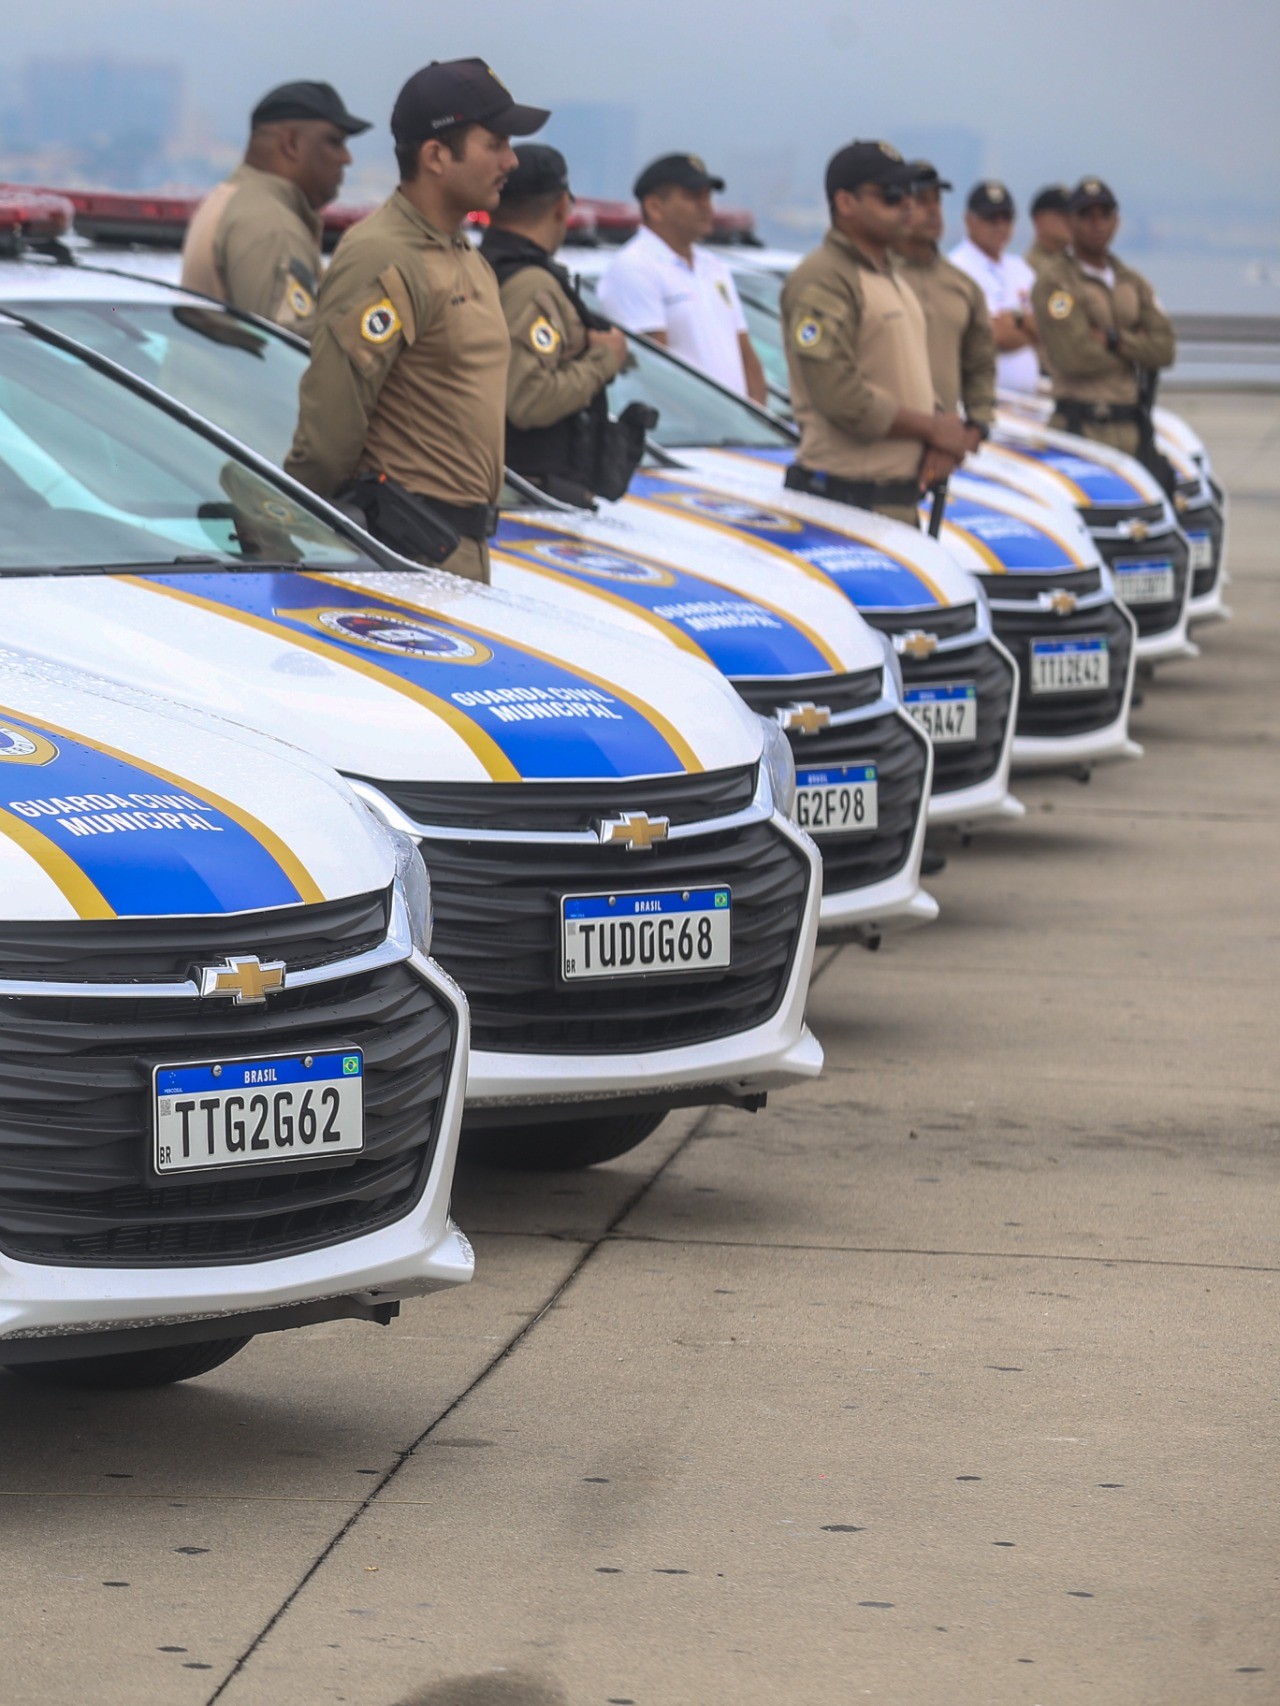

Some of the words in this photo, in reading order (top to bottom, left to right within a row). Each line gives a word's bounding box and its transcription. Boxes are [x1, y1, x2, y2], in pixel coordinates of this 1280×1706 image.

[451, 686, 555, 707] GUARDA
[547, 687, 615, 703] CIVIL
[488, 701, 623, 723] MUNICIPAL
[9, 793, 135, 818] GUARDA
[128, 793, 213, 812] CIVIL
[797, 787, 865, 827] G2F98
[56, 811, 224, 837] MUNICIPAL
[634, 900, 662, 913] BRASIL
[244, 1068, 278, 1084] BRASIL
[175, 1086, 341, 1158] TTG2G62
[160, 1146, 171, 1164] BR
